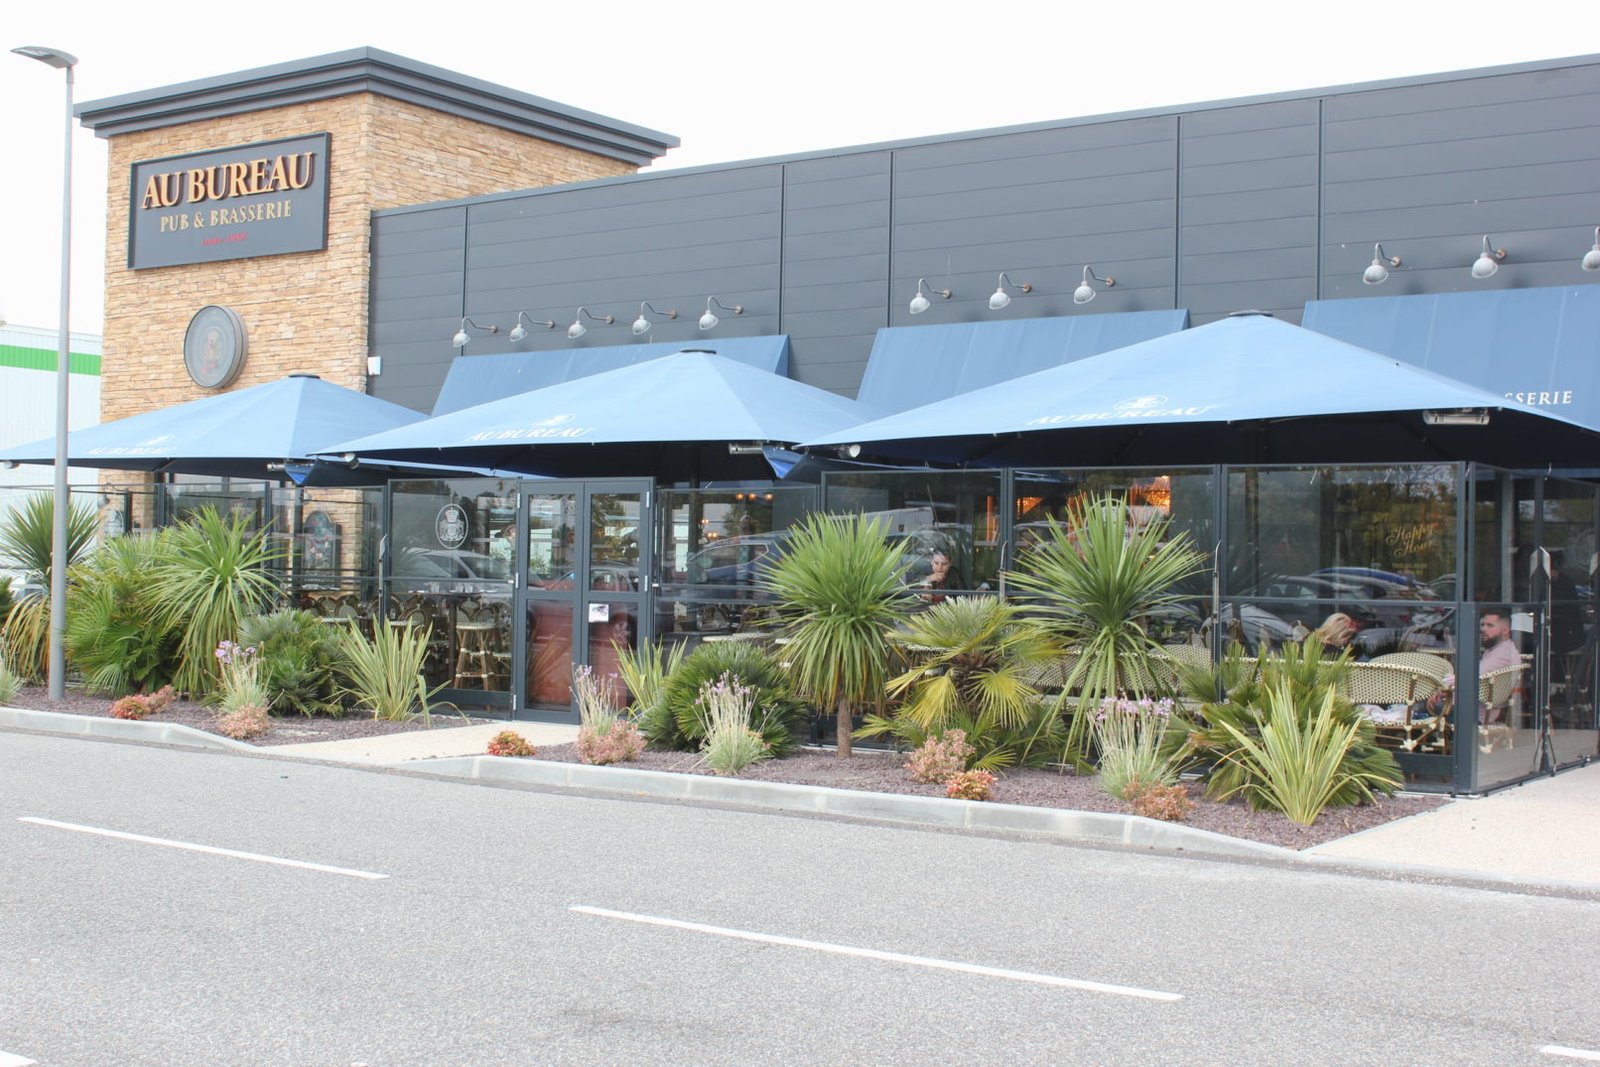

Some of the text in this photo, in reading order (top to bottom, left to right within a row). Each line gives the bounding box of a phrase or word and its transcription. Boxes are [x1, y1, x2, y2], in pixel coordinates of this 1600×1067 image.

[140, 151, 316, 210] AU BUREAU
[160, 200, 292, 232] PUB & BRASSERIE
[1385, 523, 1434, 545] Happy
